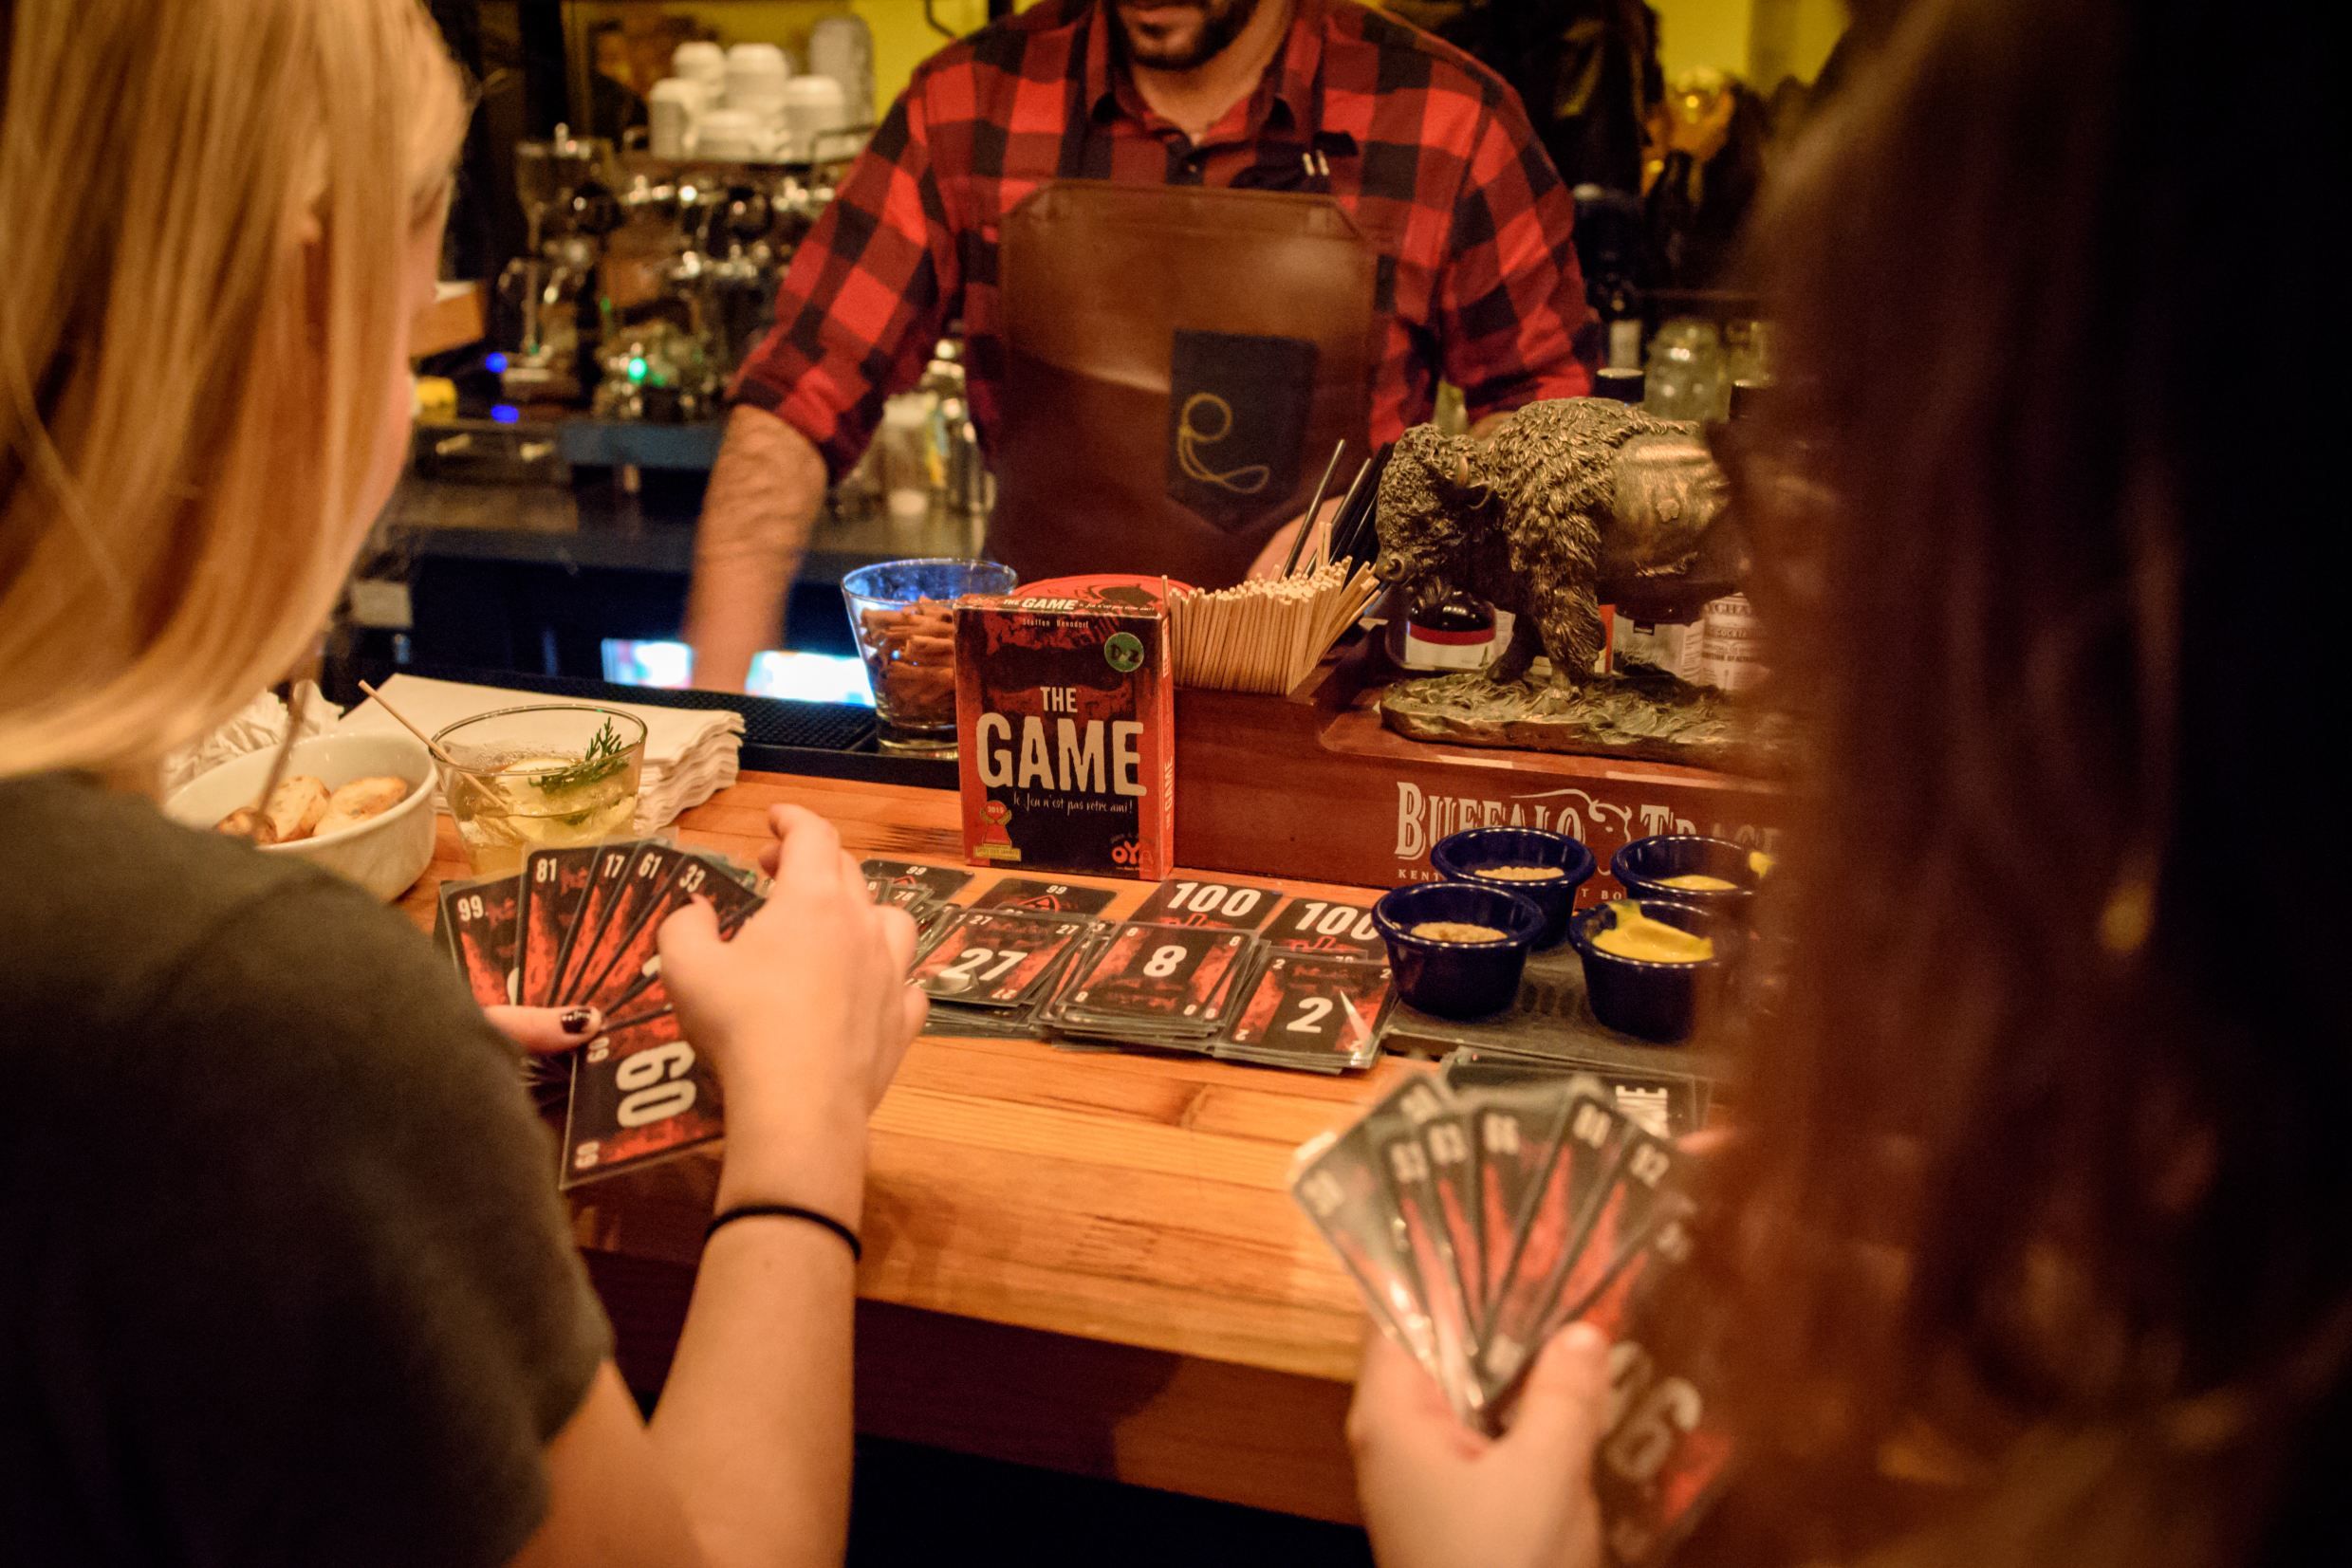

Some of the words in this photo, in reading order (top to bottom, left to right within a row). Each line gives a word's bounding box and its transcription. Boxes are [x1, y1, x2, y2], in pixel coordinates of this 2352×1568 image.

[1021, 598, 1078, 611] GAME
[1040, 686, 1078, 712] THE
[975, 712, 1147, 797] GAME
[535, 858, 557, 883] 81
[602, 854, 626, 878] 17
[638, 853, 662, 880] 61
[906, 866, 927, 876] 99
[1398, 869, 1440, 881] KENT
[678, 864, 707, 894] 33
[1046, 885, 1068, 895] 99
[457, 895, 485, 922] 99
[1167, 881, 1262, 917] 100
[969, 914, 993, 925] 27
[1055, 924, 1080, 934] 27
[1295, 902, 1380, 941] 100
[1229, 935, 1242, 947] 8
[938, 948, 1028, 982] 27
[1142, 944, 1187, 978] 8
[1272, 958, 1286, 969] 2
[1380, 968, 1392, 979] 2
[1286, 997, 1333, 1033] 2
[1235, 1029, 1250, 1042] 2
[615, 1040, 697, 1128] 60
